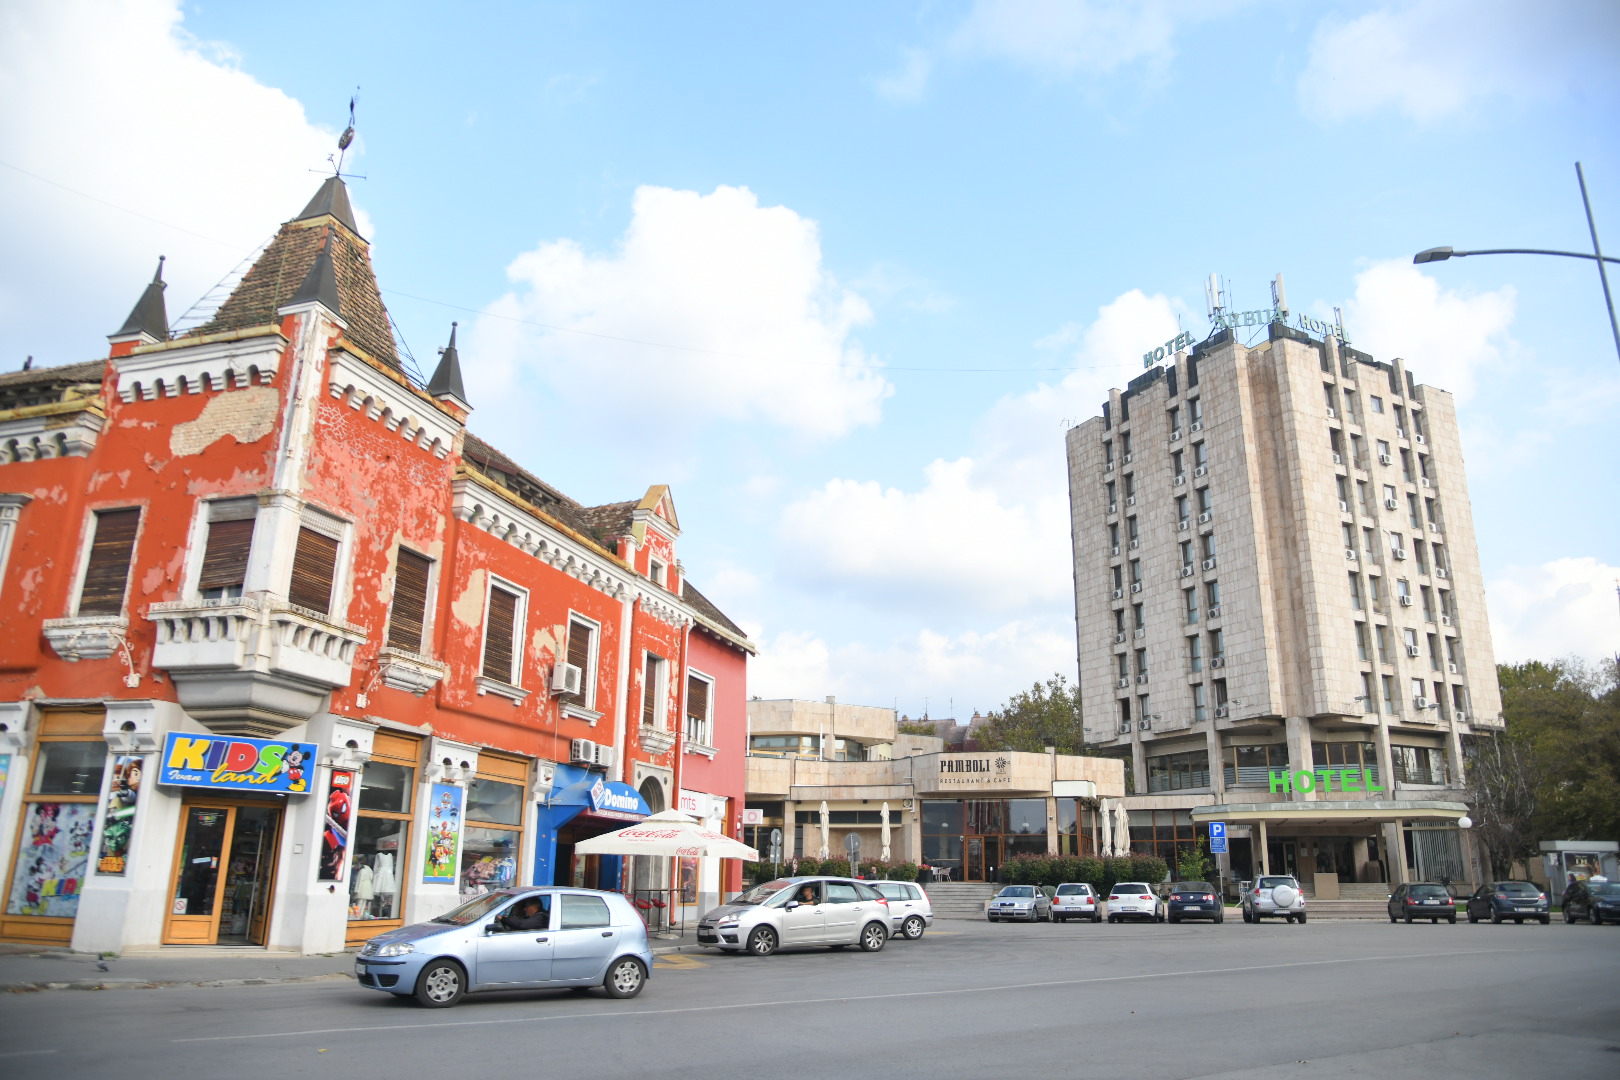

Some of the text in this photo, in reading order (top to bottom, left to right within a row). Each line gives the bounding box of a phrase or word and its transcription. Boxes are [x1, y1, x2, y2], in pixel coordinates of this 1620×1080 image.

[1299, 313, 1352, 344] HOTEL
[1143, 331, 1196, 369] HOTEL
[167, 737, 288, 774] KIDS
[940, 760, 990, 772] PAMBOLI
[210, 762, 281, 784] land
[1268, 769, 1385, 795] HOTEL
[604, 788, 639, 811] Domino
[681, 795, 697, 811] mts
[1213, 824, 1222, 836] P
